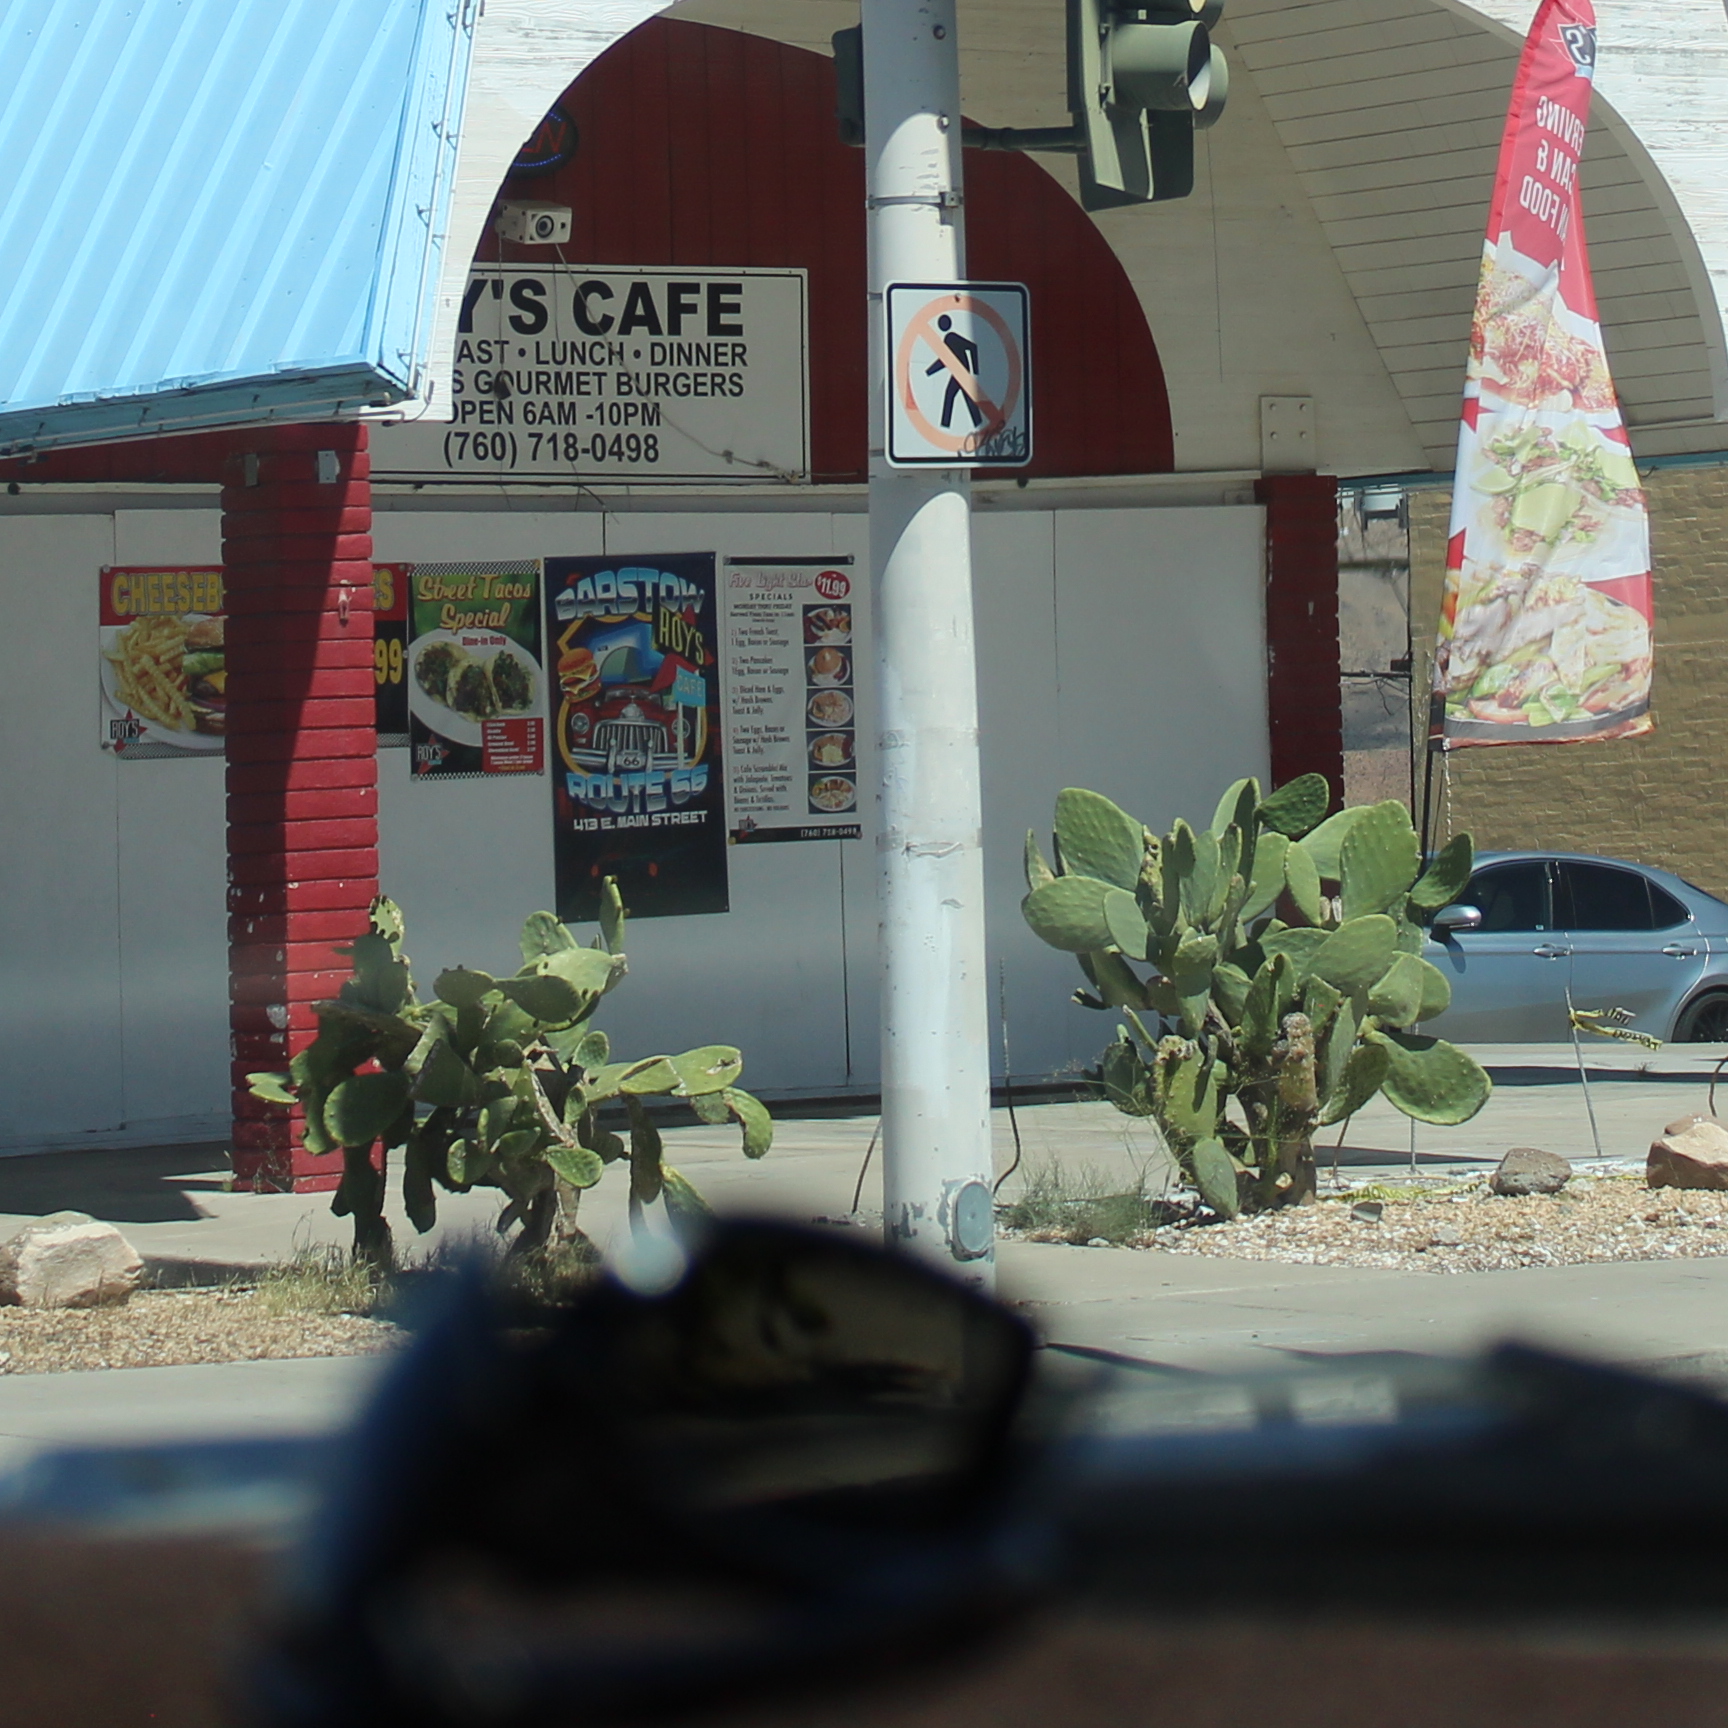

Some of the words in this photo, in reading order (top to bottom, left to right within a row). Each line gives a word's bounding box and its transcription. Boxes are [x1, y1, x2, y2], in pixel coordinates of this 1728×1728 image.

[573, 280, 744, 337] CAFE
[534, 340, 624, 367] LUNCH
[650, 342, 748, 368] DINNER
[474, 369, 607, 396] GOURMET
[616, 372, 744, 398] BURGERS
[522, 401, 576, 426] 6AM
[443, 430, 517, 469] (760)
[527, 431, 659, 463] 718-0498
[111, 571, 224, 615] CHEESEB
[417, 575, 476, 601] Street
[479, 573, 532, 601] Tacos
[555, 567, 705, 621] BARSTOW
[817, 575, 847, 598] $11.99
[439, 601, 512, 636] Special
[462, 636, 489, 646] Dine-in
[489, 635, 507, 647] Only
[660, 607, 704, 666] ROY'S
[677, 676, 704, 699] CAFE
[111, 720, 140, 740] ROY'S
[416, 744, 443, 762] ROY'S
[623, 757, 640, 766] 66
[566, 771, 666, 813] ROUTE
[671, 764, 709, 805] 66
[573, 819, 598, 831] 413
[601, 817, 615, 830] E.
[617, 814, 650, 829] MAIN
[651, 810, 708, 826] STREET
